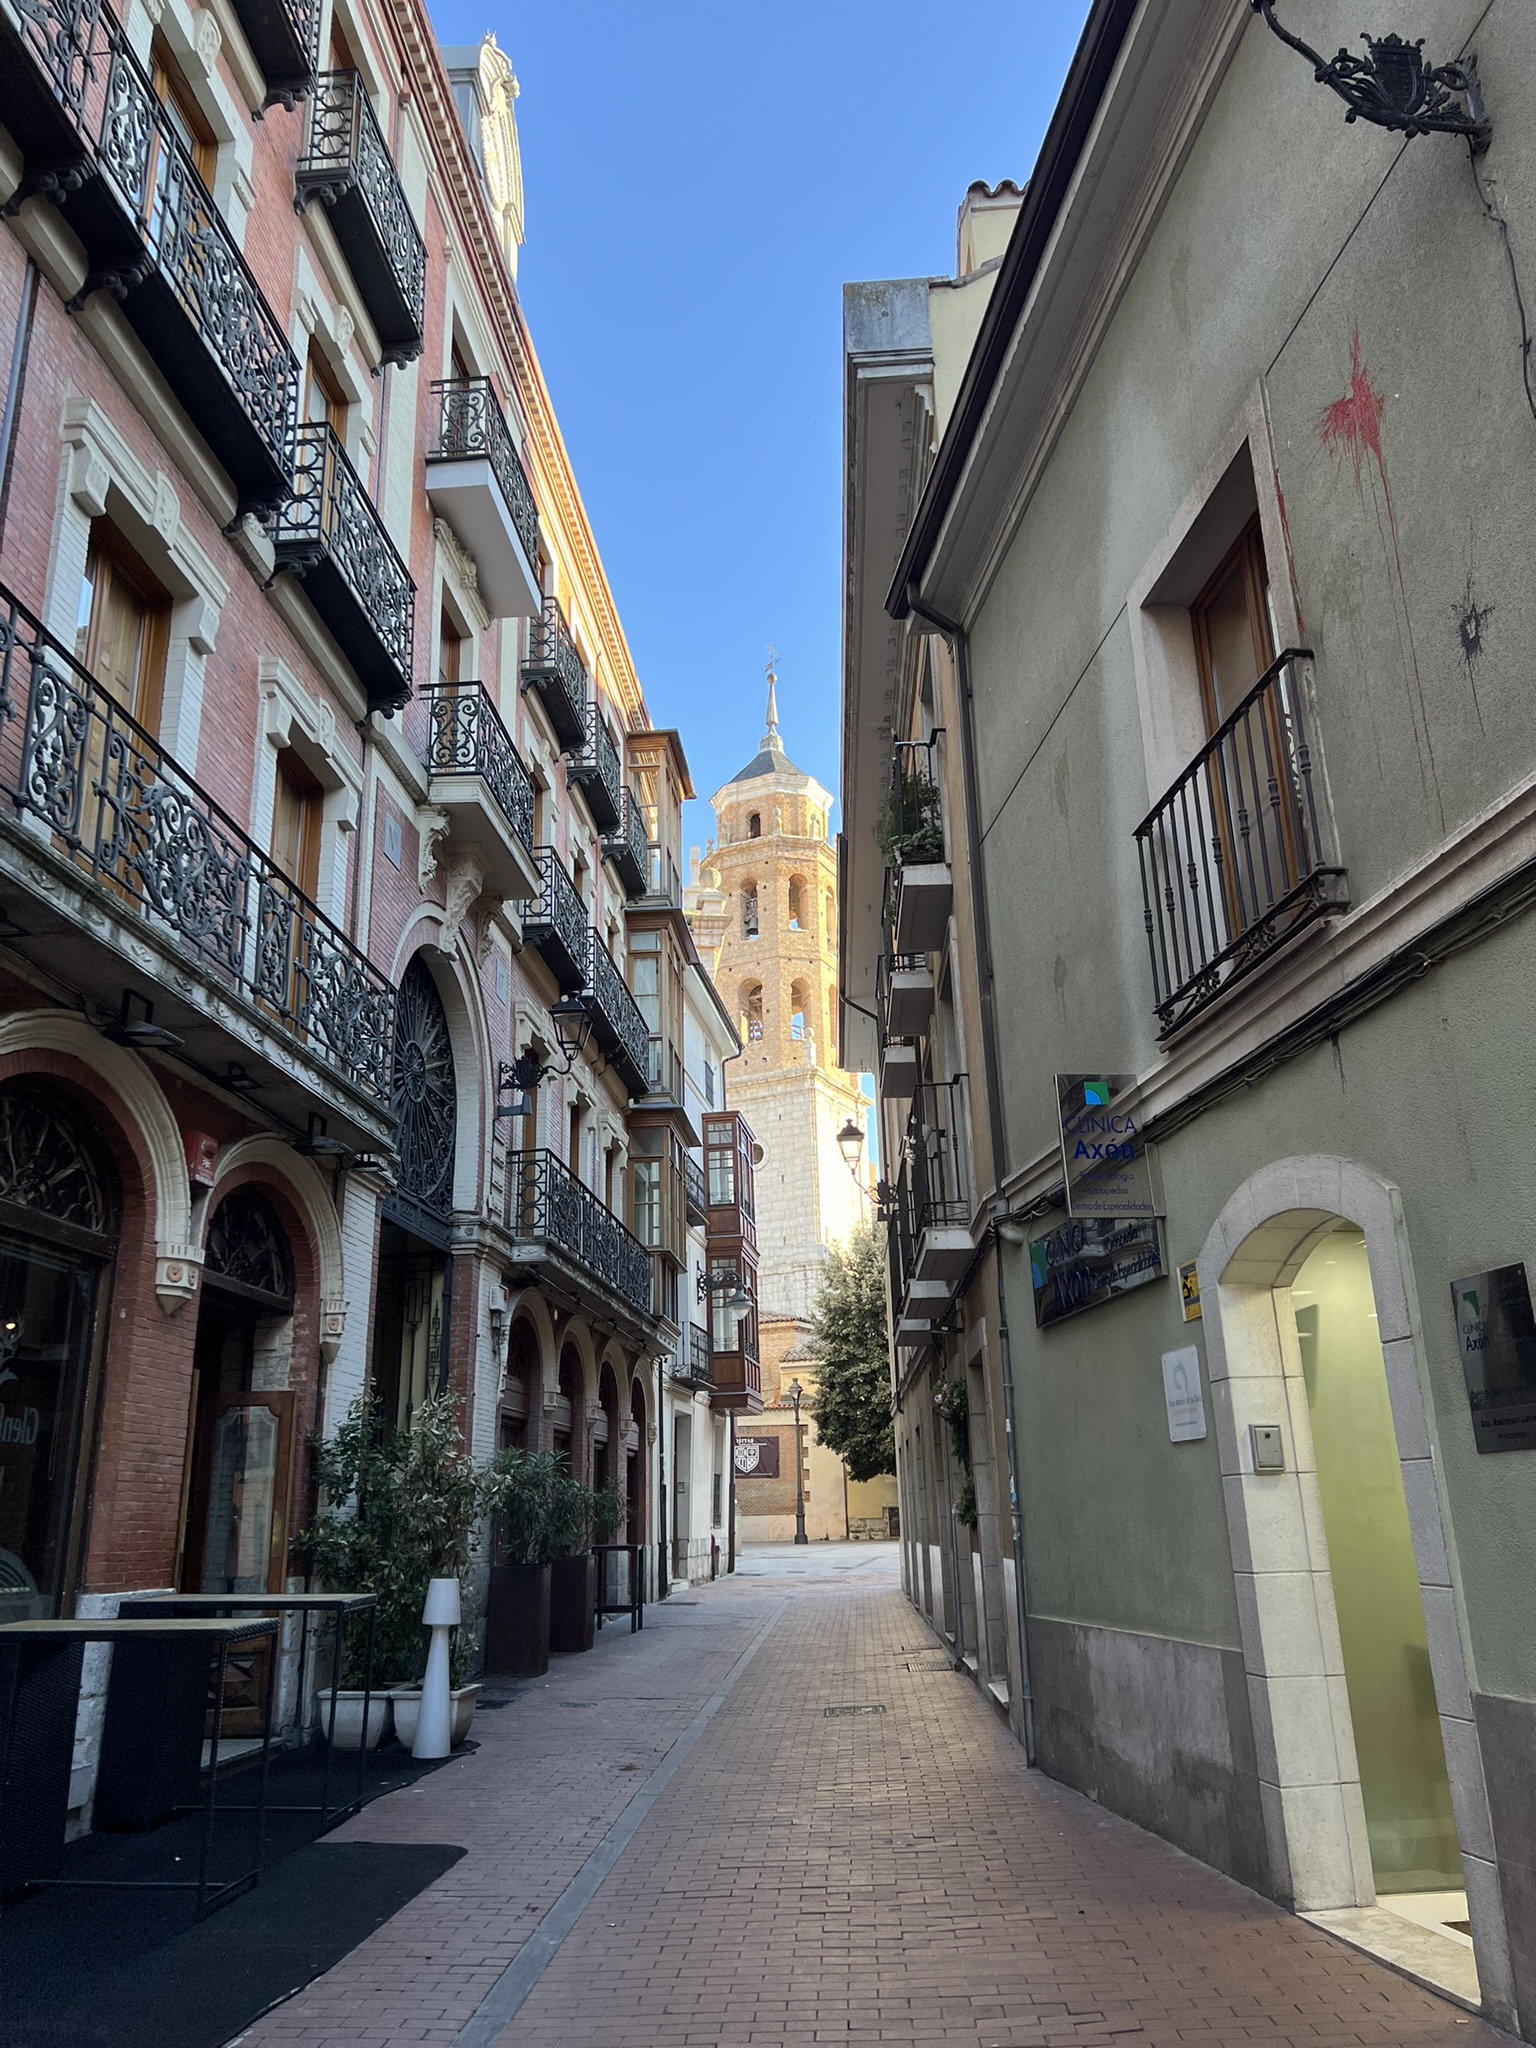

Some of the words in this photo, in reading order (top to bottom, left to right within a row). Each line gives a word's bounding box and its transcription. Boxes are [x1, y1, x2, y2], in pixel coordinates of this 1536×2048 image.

[1073, 1137, 1136, 1160] Axón
[1087, 1184, 1128, 1197] Ortopedia
[1093, 1200, 1102, 1211] de
[1102, 1199, 1152, 1213] Especialidades
[1466, 1333, 1490, 1352] Axón
